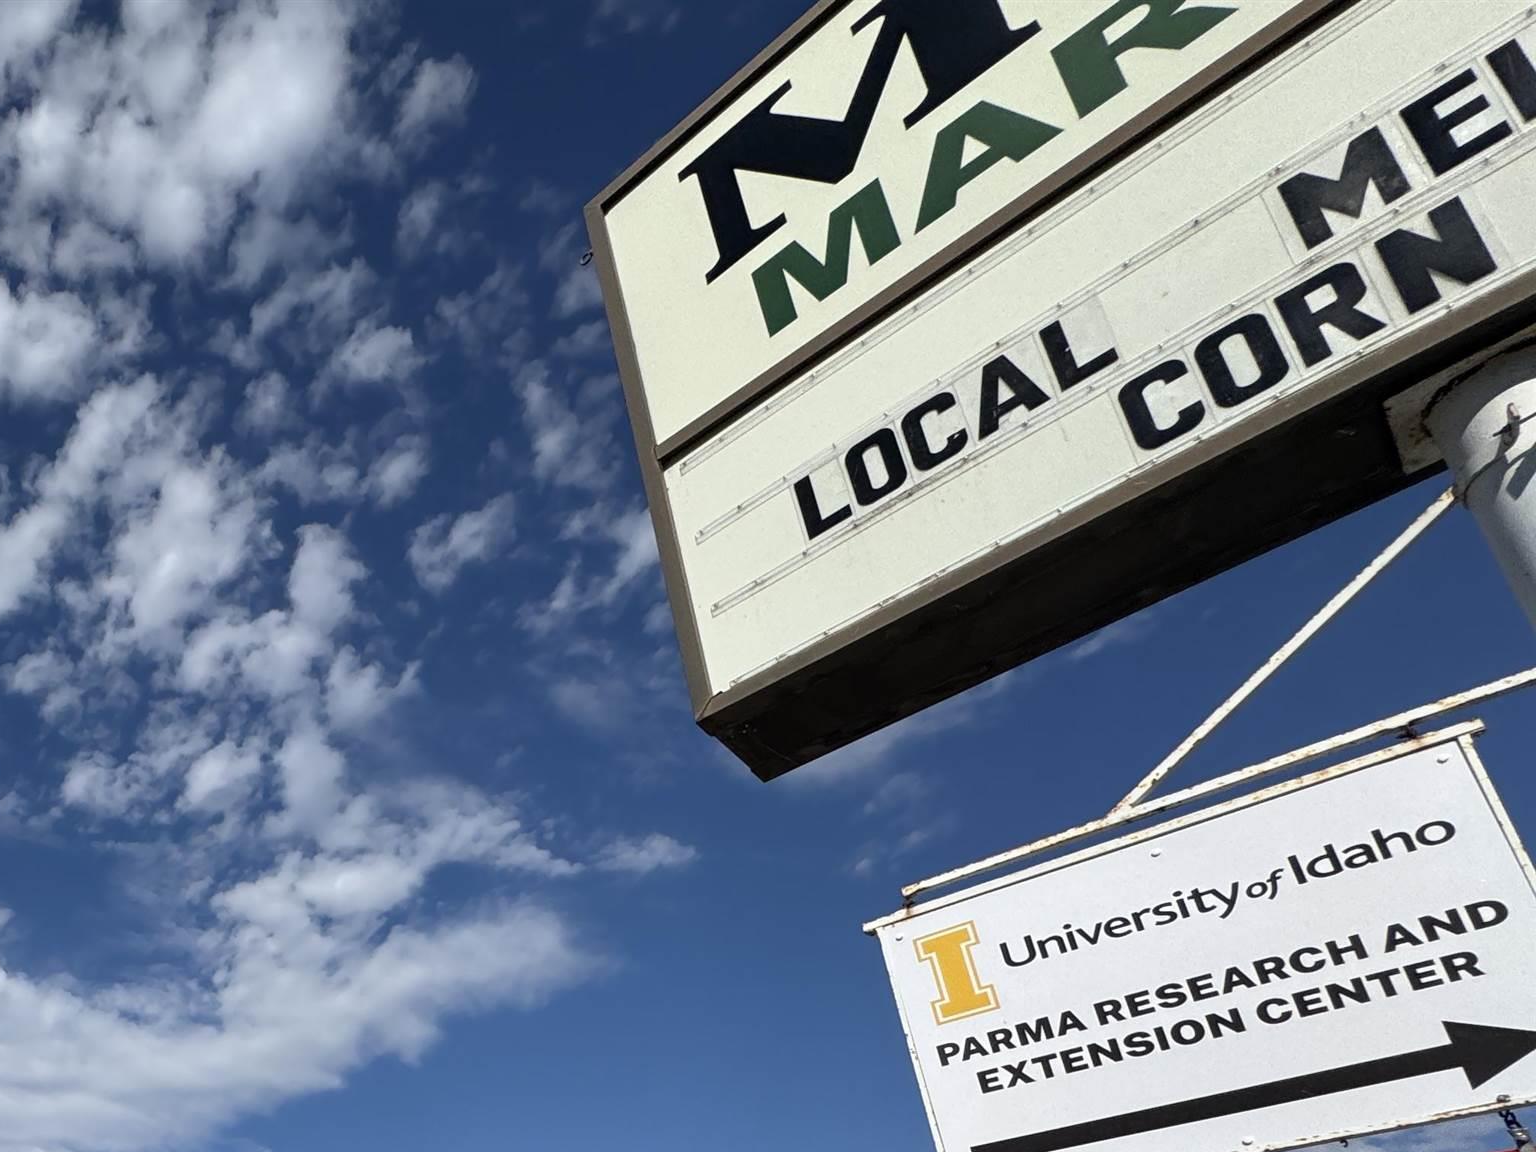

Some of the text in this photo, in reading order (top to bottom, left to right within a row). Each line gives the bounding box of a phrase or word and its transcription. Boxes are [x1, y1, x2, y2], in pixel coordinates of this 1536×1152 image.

[1117, 195, 1498, 450] CORN
[793, 319, 1120, 540] LOCAL
[999, 820, 1456, 967] University of Idaho
[936, 900, 1509, 1067] PARMA RESEARCH AND
[976, 951, 1487, 1094] EXTENSION CENTER
